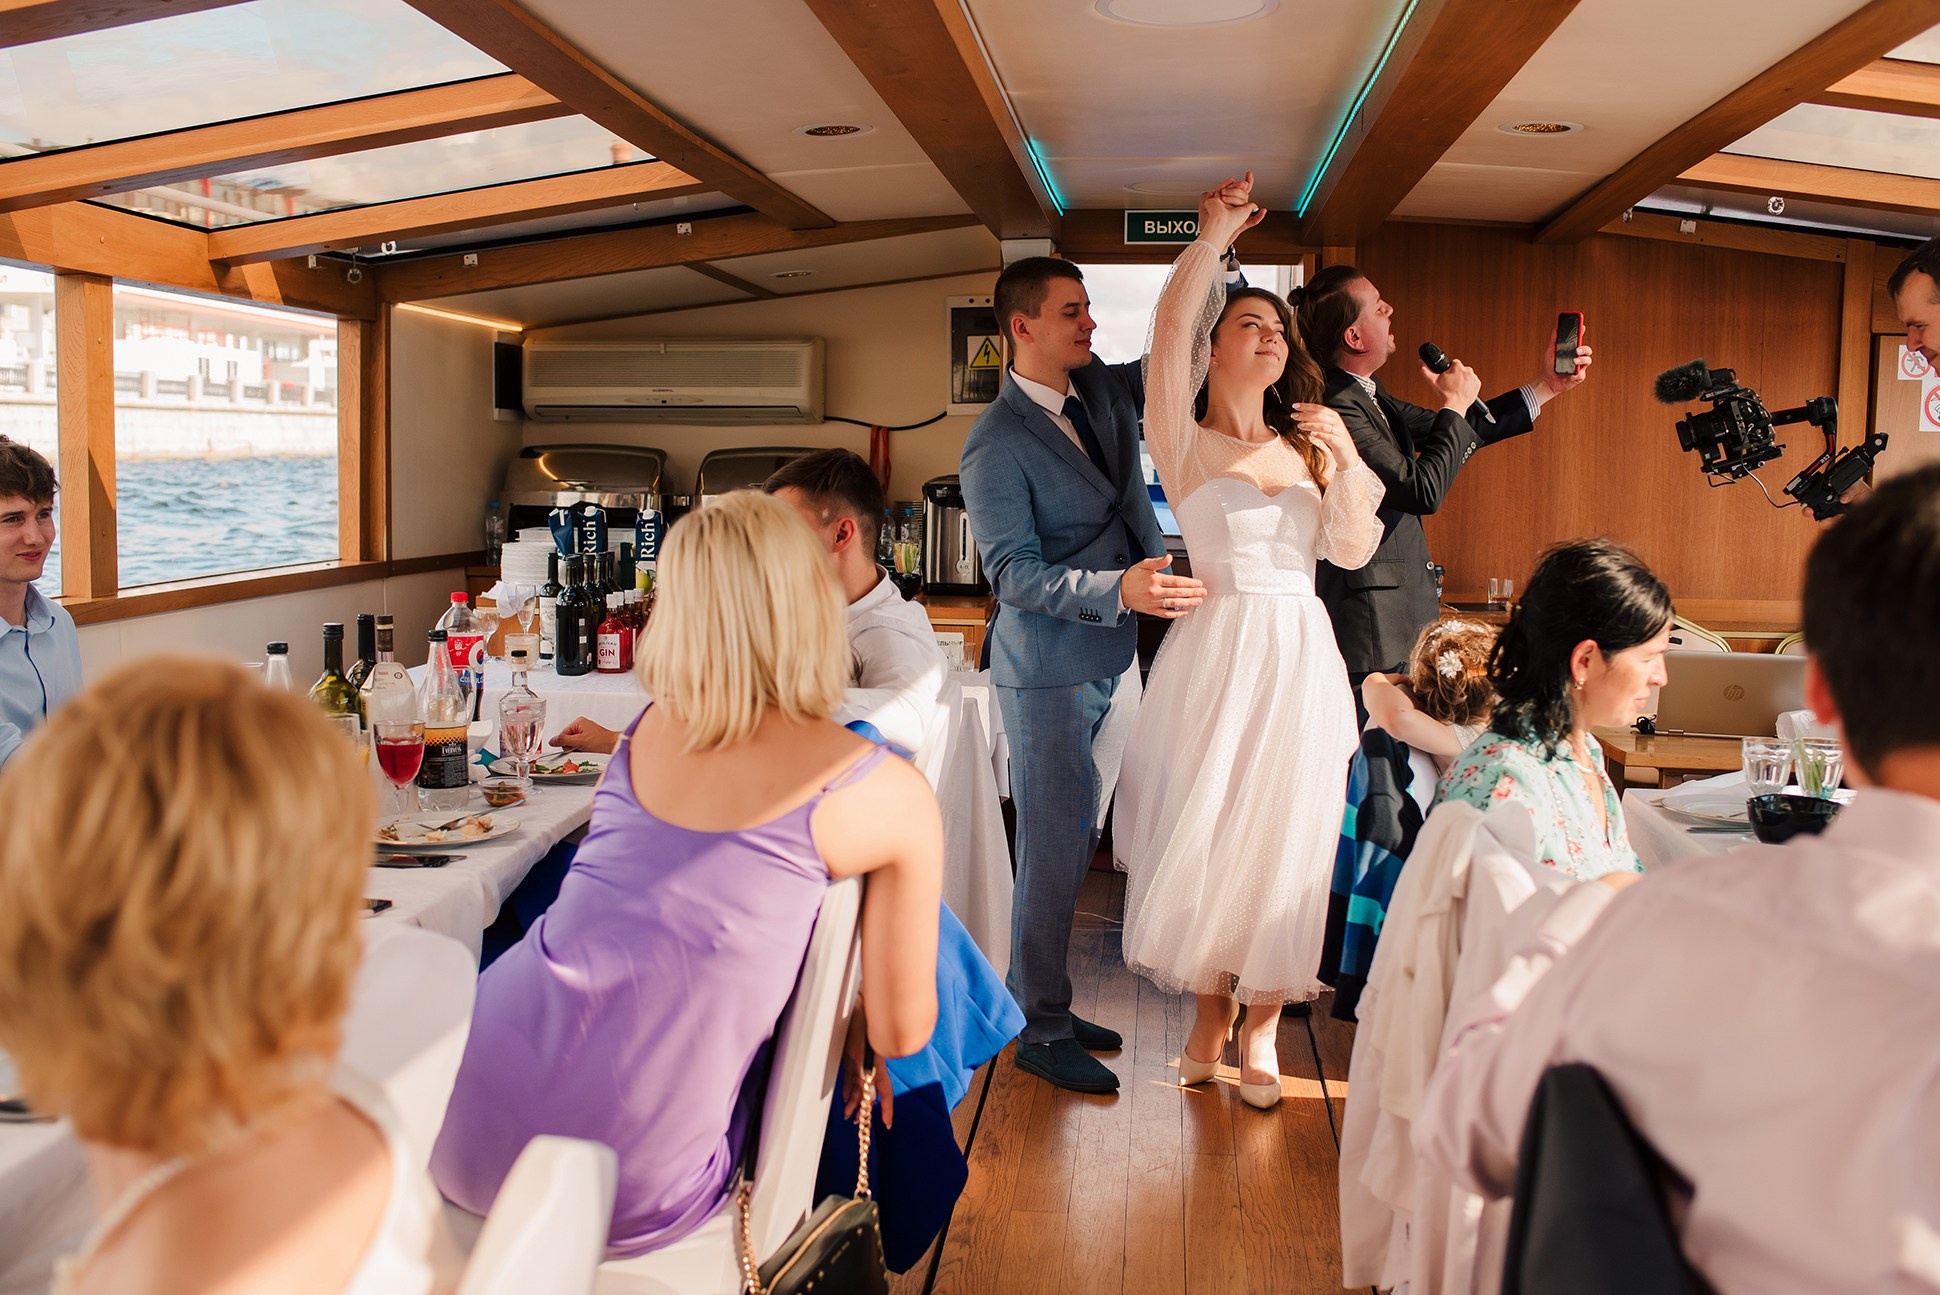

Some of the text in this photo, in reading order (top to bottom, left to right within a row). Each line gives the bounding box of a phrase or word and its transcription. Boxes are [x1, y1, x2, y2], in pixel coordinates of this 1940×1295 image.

[1144, 220, 1201, 236] ВЫХО
[583, 520, 597, 556] Rich
[640, 522, 655, 559] Rich
[599, 648, 615, 657] GIN
